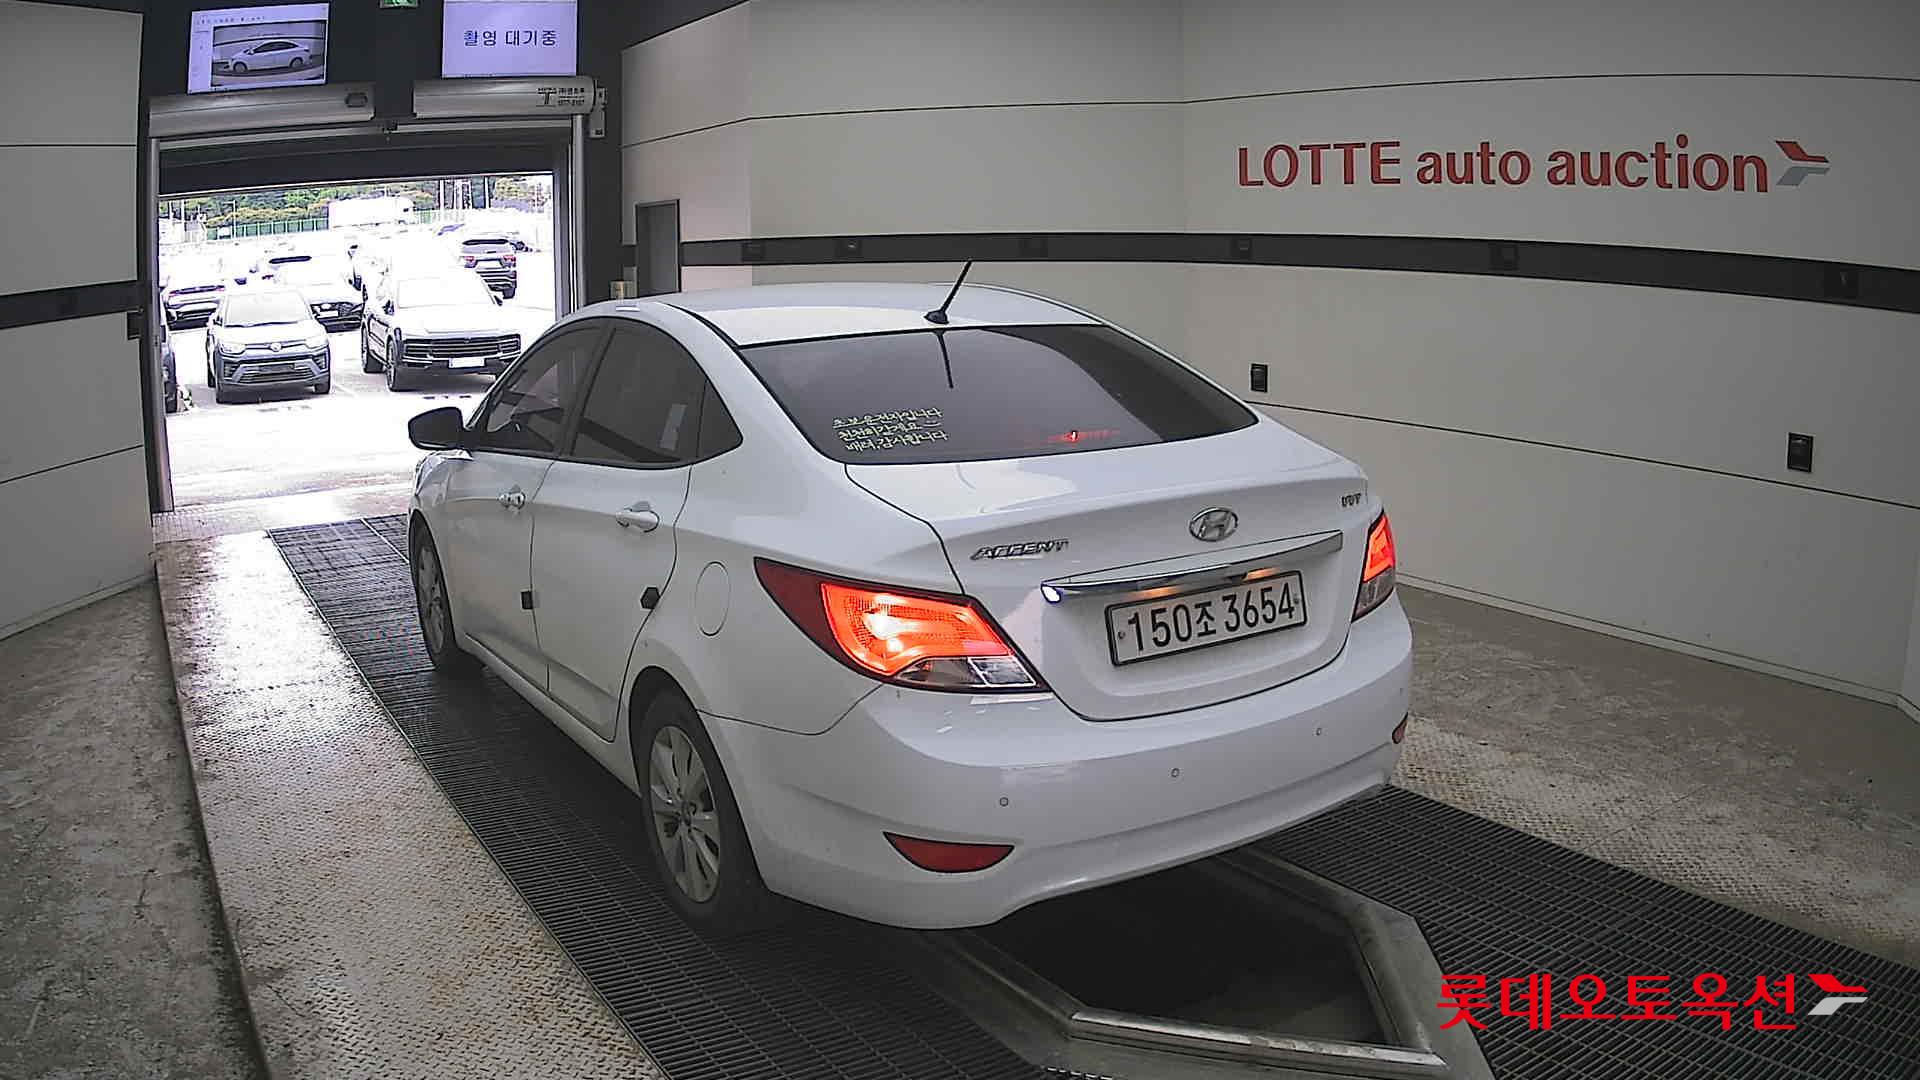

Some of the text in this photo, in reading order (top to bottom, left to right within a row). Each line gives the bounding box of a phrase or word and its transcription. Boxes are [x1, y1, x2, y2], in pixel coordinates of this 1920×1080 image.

[505, 29, 557, 47] 대기중
[1238, 134, 1769, 193] LOTTE auto auction
[969, 538, 1070, 560] ACCENT
[1127, 582, 1295, 651] 150조 3654
